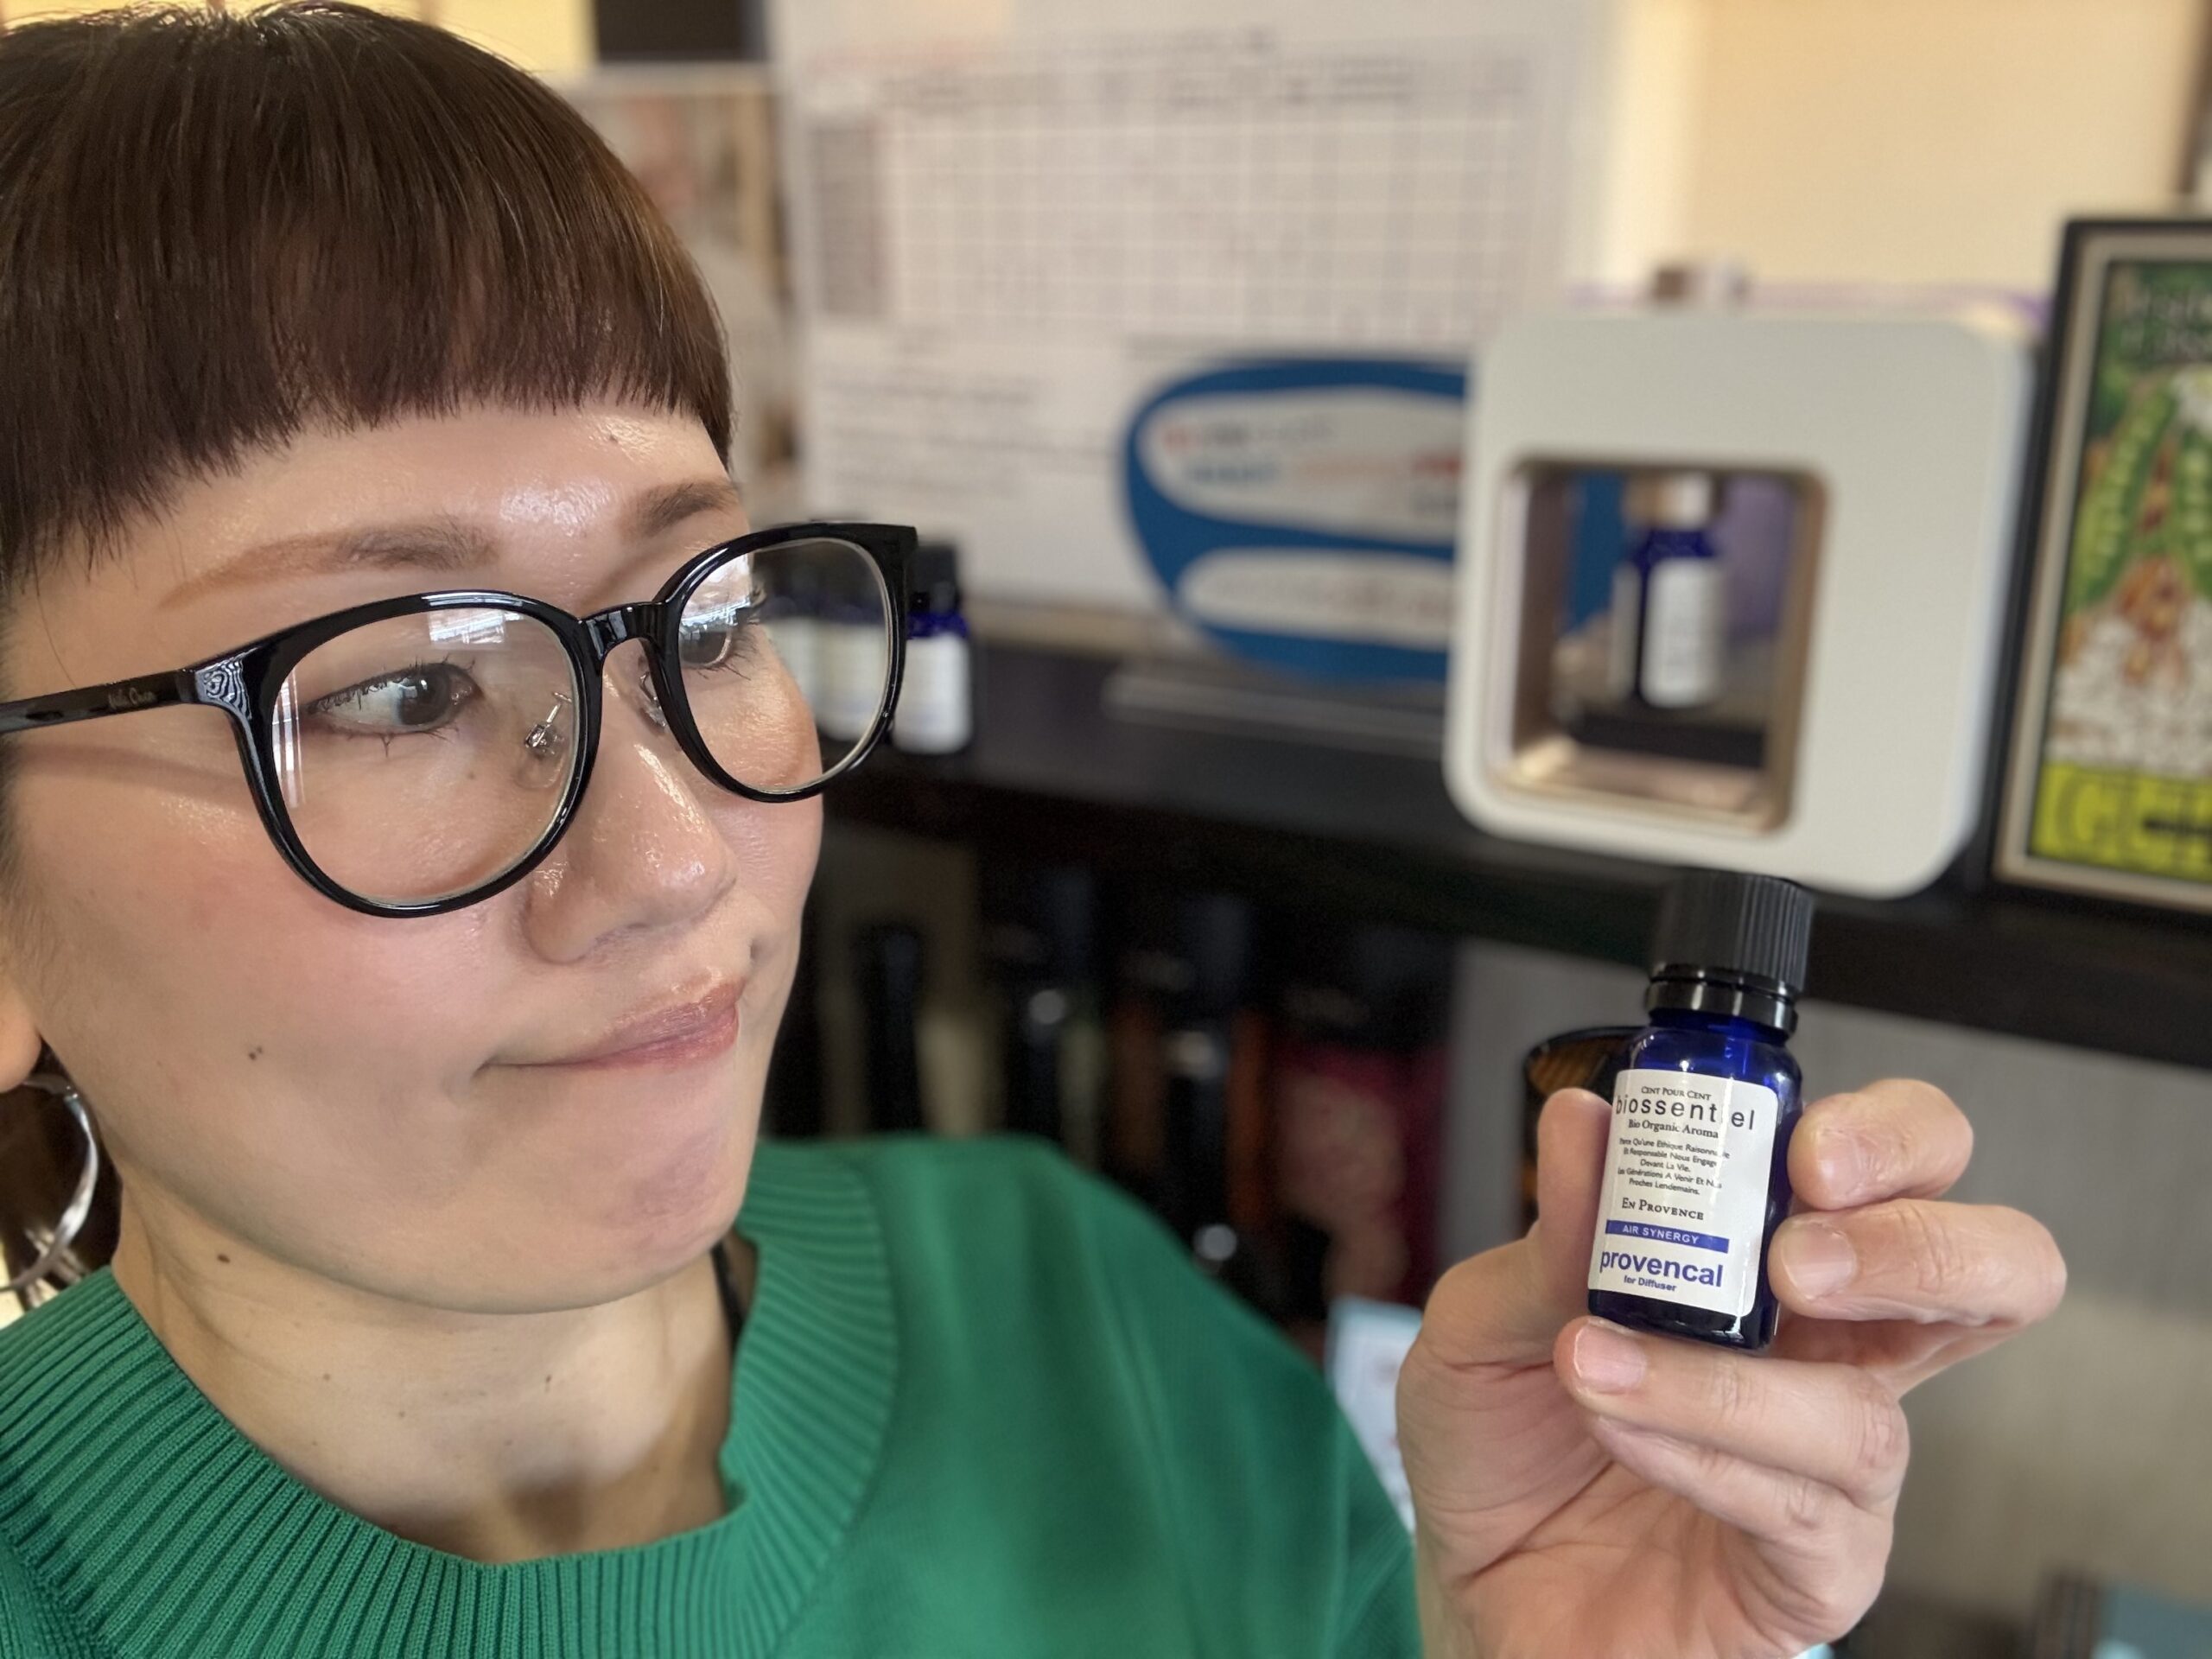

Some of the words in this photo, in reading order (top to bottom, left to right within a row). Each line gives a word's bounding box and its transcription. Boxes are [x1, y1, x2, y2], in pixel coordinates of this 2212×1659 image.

[1662, 1087, 1685, 1097] POUR
[1687, 1090, 1712, 1101] CENT
[1616, 1094, 1755, 1129] biossentel
[1629, 1119, 1641, 1128] Bio
[1642, 1120, 1679, 1133] Organic
[1682, 1124, 1719, 1138] Aroma
[1630, 1147, 1668, 1158] Responsable
[1670, 1153, 1690, 1161] Nous
[1656, 1141, 1683, 1151] Ethique
[1686, 1144, 1731, 1159] Raisonne
[1640, 1159, 1664, 1168] Devant
[1629, 1178, 1653, 1187] Proches
[1674, 1173, 1694, 1183] Venir
[1622, 1197, 1637, 1209] EN
[1639, 1199, 1704, 1220] PROVENCE
[1623, 1224, 1642, 1235] AIR
[1643, 1227, 1700, 1244] SYNERGY
[1599, 1250, 1724, 1287] provencal
[1624, 1274, 1636, 1284] for
[1638, 1278, 1677, 1292] Diffuser
